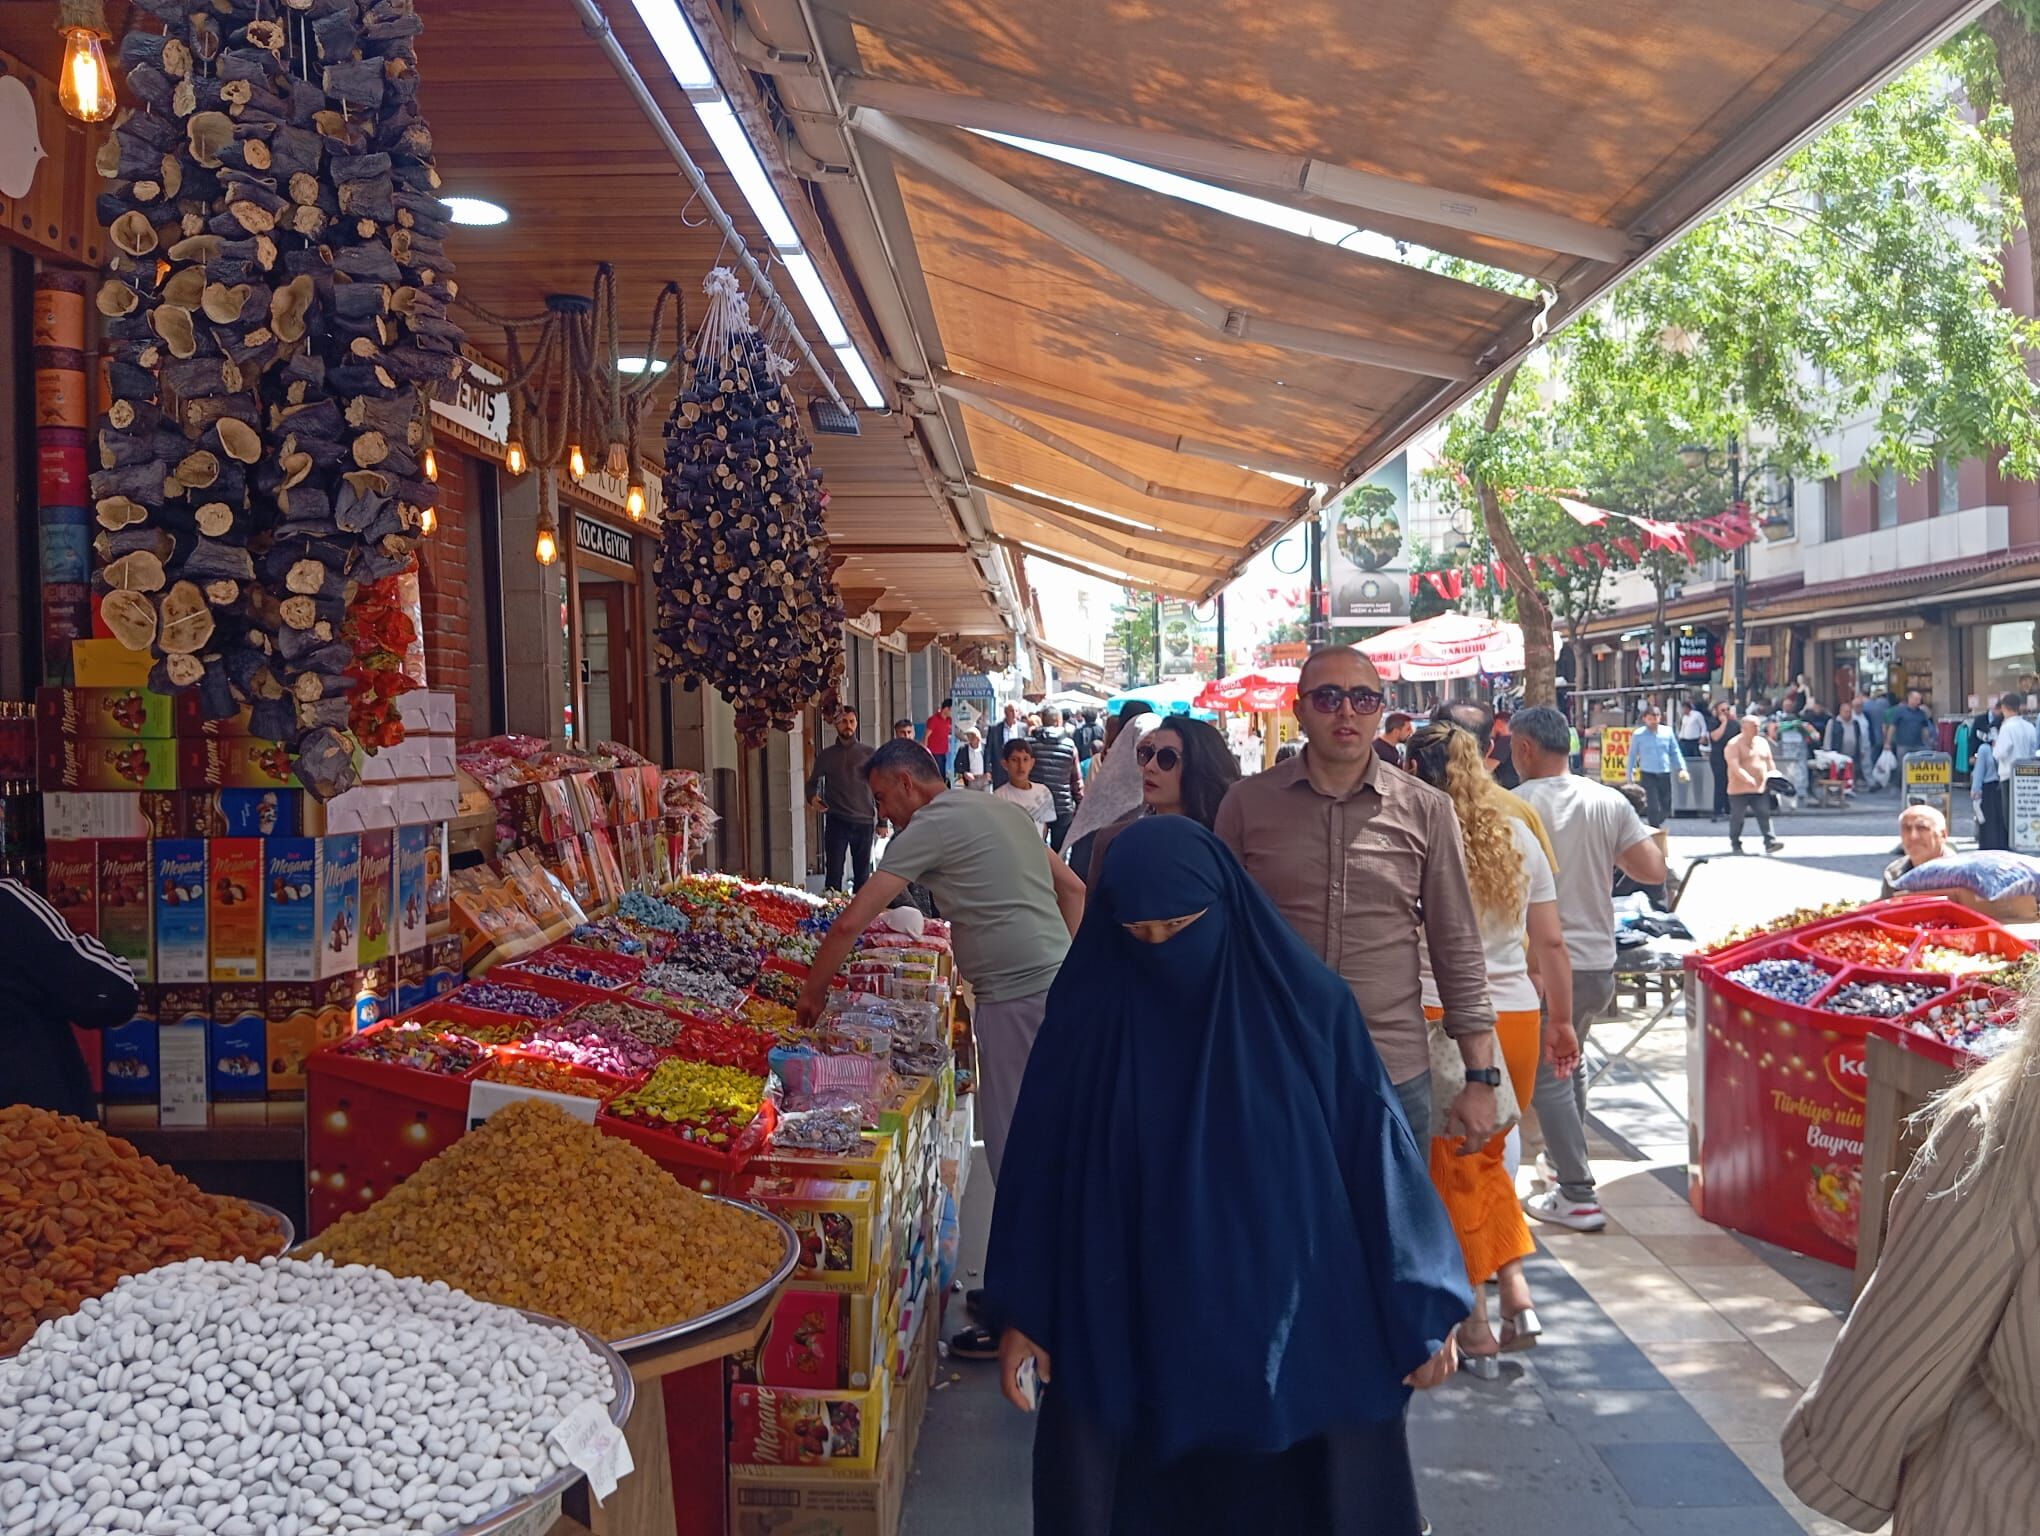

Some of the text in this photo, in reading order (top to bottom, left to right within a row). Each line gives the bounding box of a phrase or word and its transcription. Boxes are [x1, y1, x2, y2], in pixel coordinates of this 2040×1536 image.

[459, 378, 496, 431] EMİŞ
[575, 519, 630, 561] KOCA GİYİM
[61, 688, 81, 734] Megane
[1606, 744, 1629, 756] PA
[1610, 730, 1633, 743] OT
[61, 740, 82, 786] Megane
[204, 738, 226, 785] Megane
[102, 859, 147, 881] Megane
[159, 858, 204, 881] Megane
[269, 857, 314, 879] Megane
[752, 1386, 785, 1463] Megane
